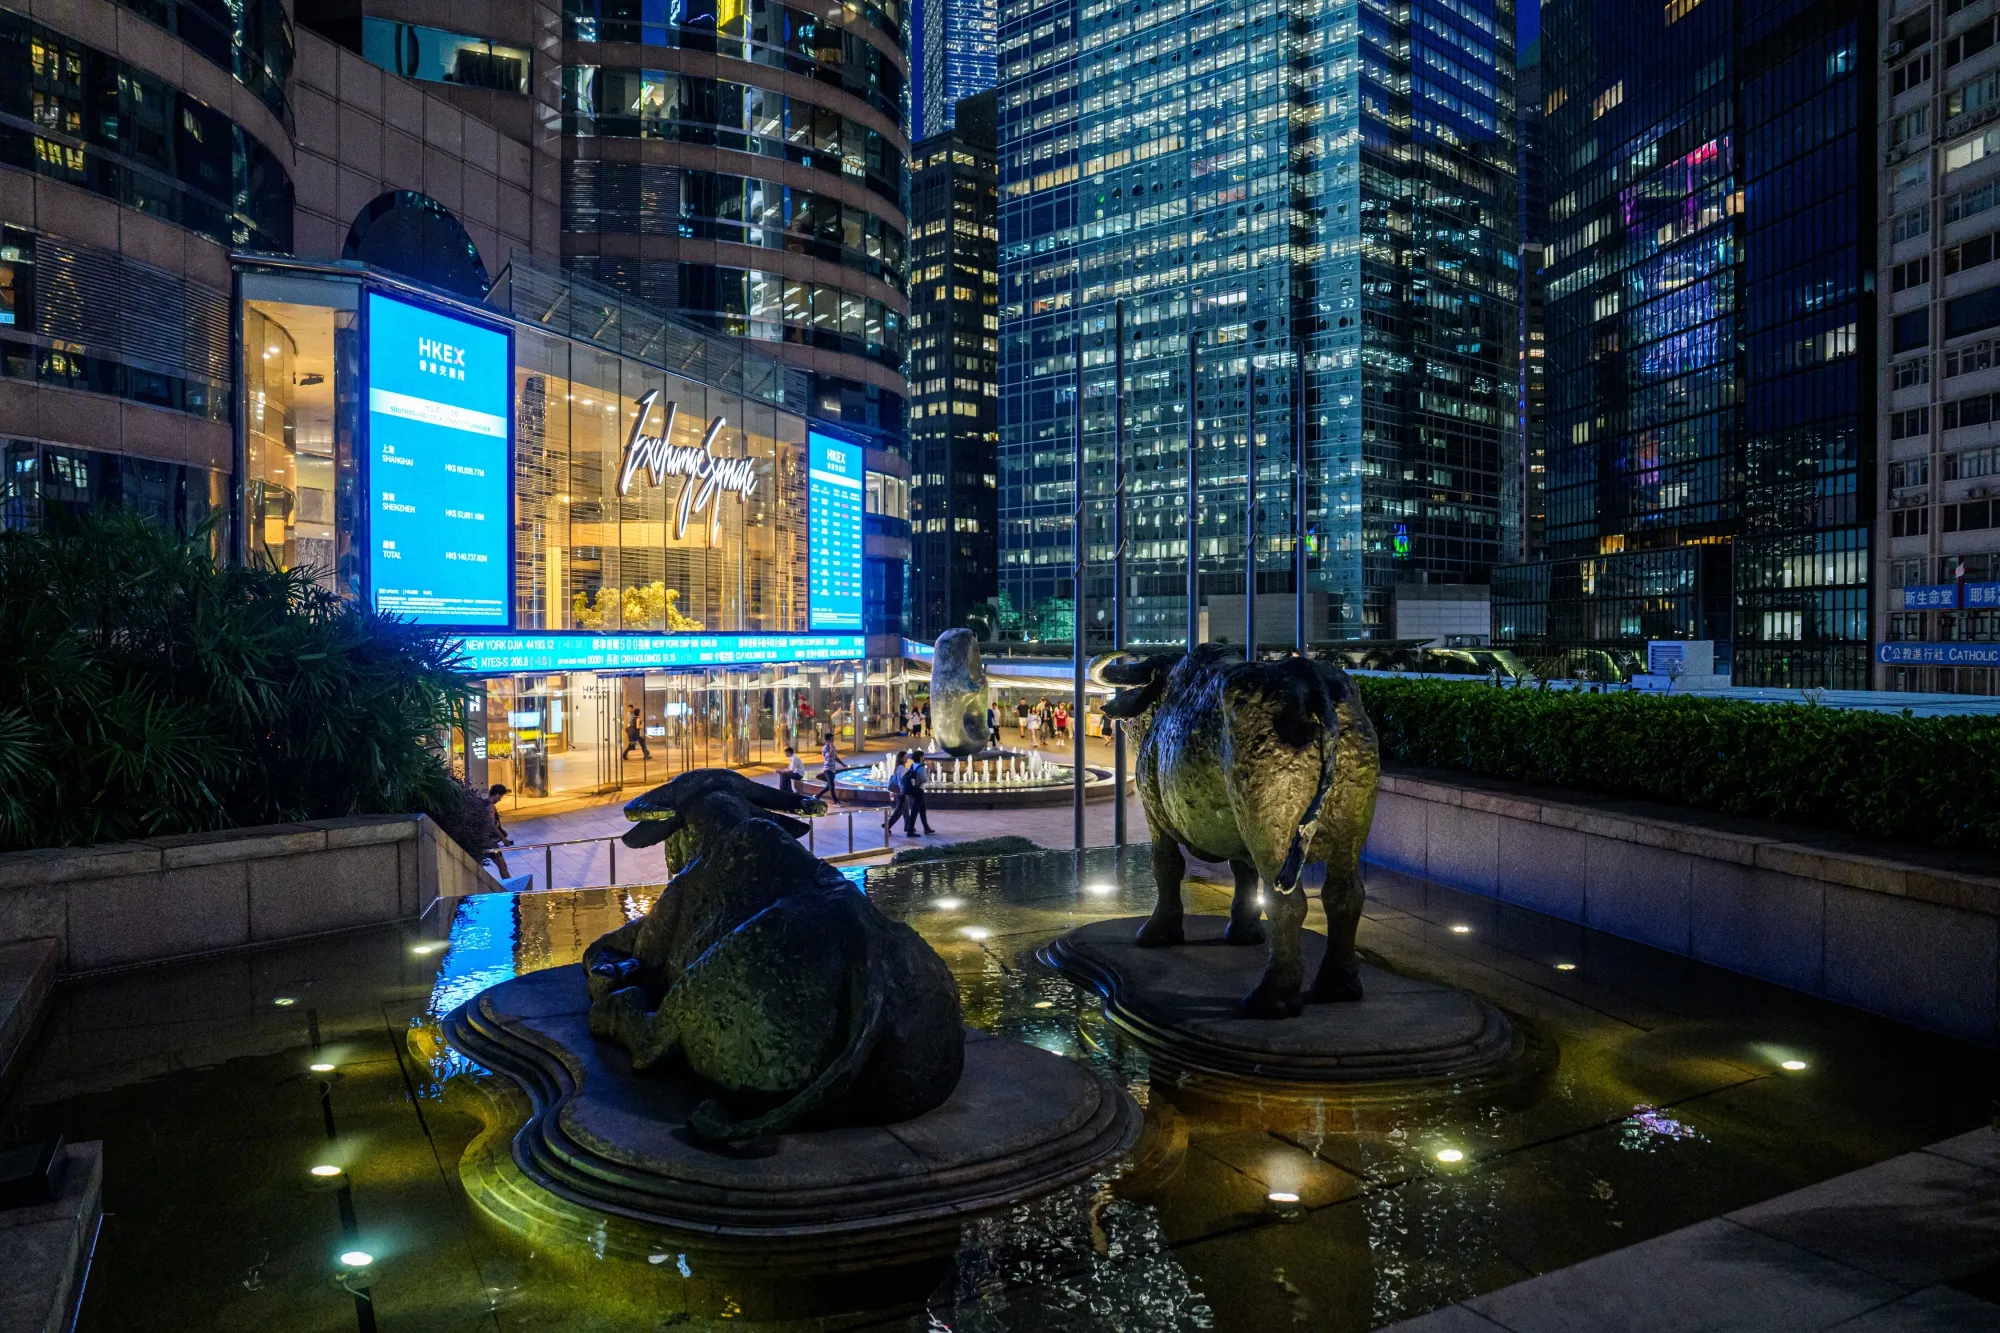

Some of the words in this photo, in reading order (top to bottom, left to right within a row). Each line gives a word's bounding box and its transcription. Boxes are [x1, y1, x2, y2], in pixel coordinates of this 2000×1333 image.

[419, 336, 465, 367] HKEX
[382, 455, 414, 466] SHANGHAI
[382, 503, 416, 513] SHENZHEN
[383, 550, 402, 559] TOTAL
[1905, 590, 1952, 605] 新生命堂
[466, 640, 484, 650] NEW
[485, 640, 507, 650] YORK
[508, 640, 524, 650] DJIA
[633, 653, 661, 663] HOLDINGS
[1892, 647, 1944, 660] 公教進行社
[1949, 648, 1998, 661] CATHOLIC
[481, 657, 509, 668] NTES-S
